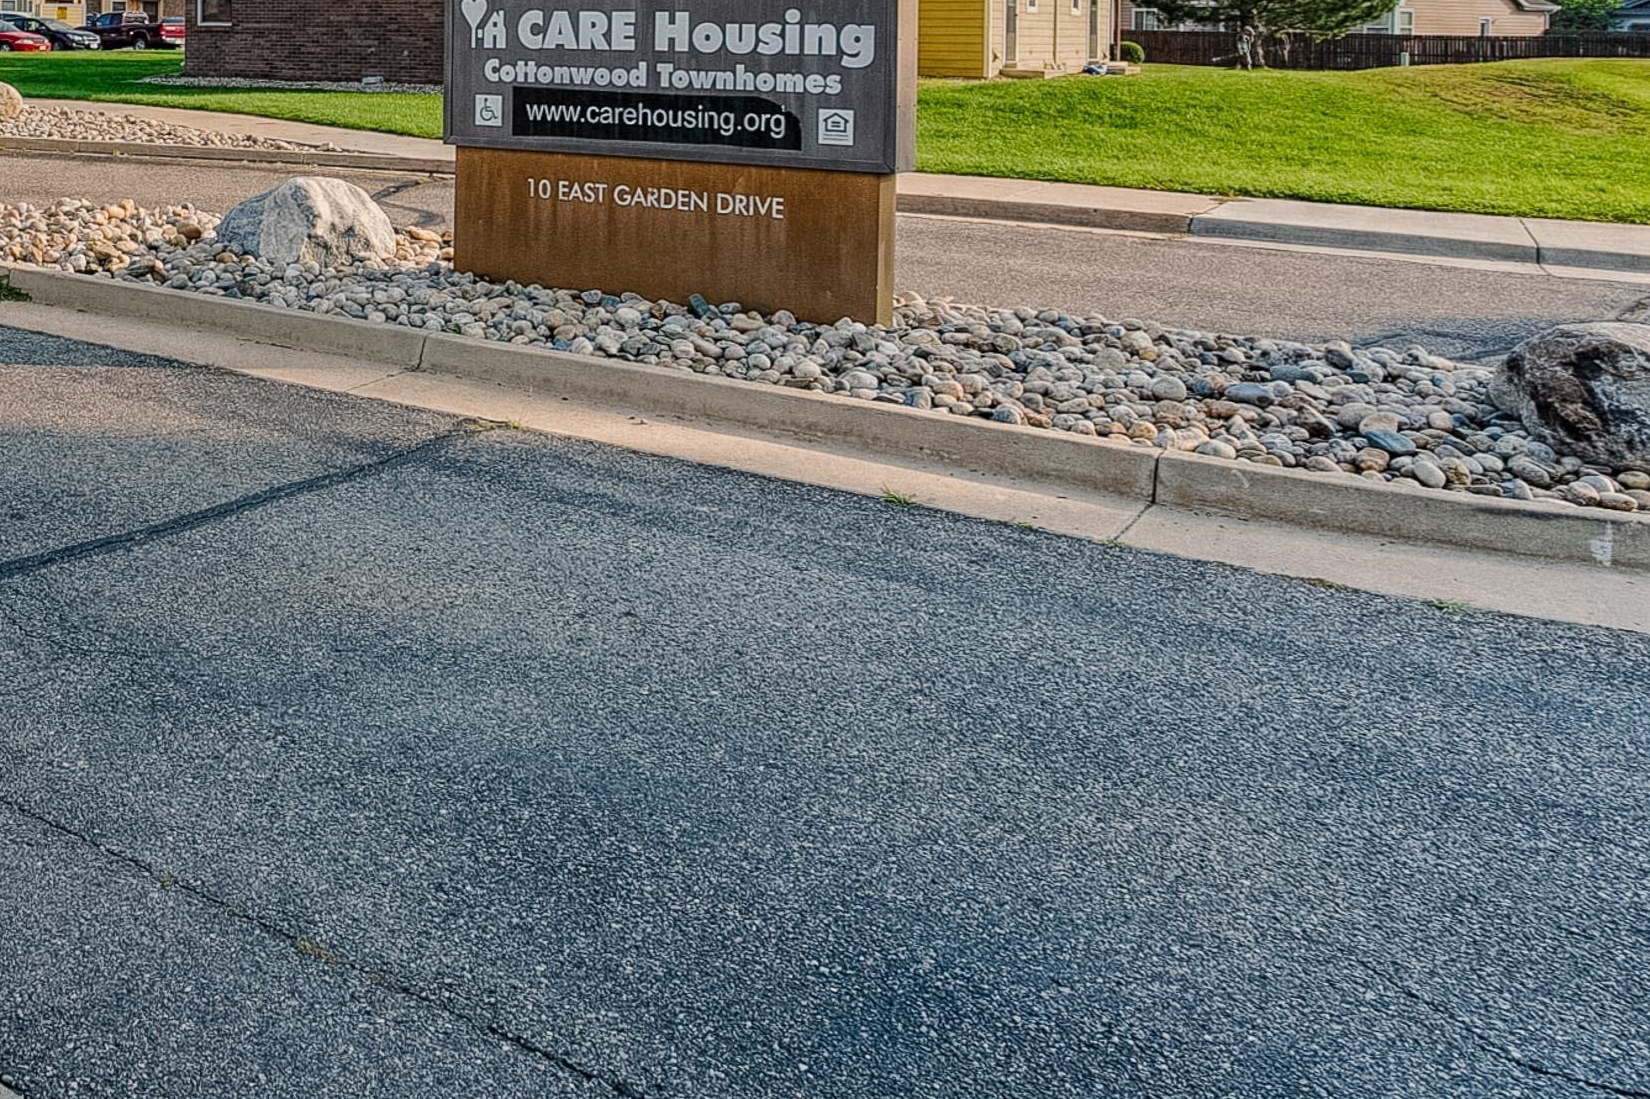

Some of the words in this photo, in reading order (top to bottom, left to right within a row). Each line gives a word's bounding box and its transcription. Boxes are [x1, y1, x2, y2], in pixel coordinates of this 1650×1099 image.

[517, 9, 637, 51] CARE
[654, 7, 876, 69] Housing
[483, 58, 648, 88] Cottonwood
[655, 62, 843, 95] Townhomes
[525, 102, 787, 139] www.carehousing.org
[526, 178, 551, 199] 10
[558, 180, 608, 204] EAST
[613, 184, 708, 213] GARDEN
[716, 192, 786, 220] DRIVE
